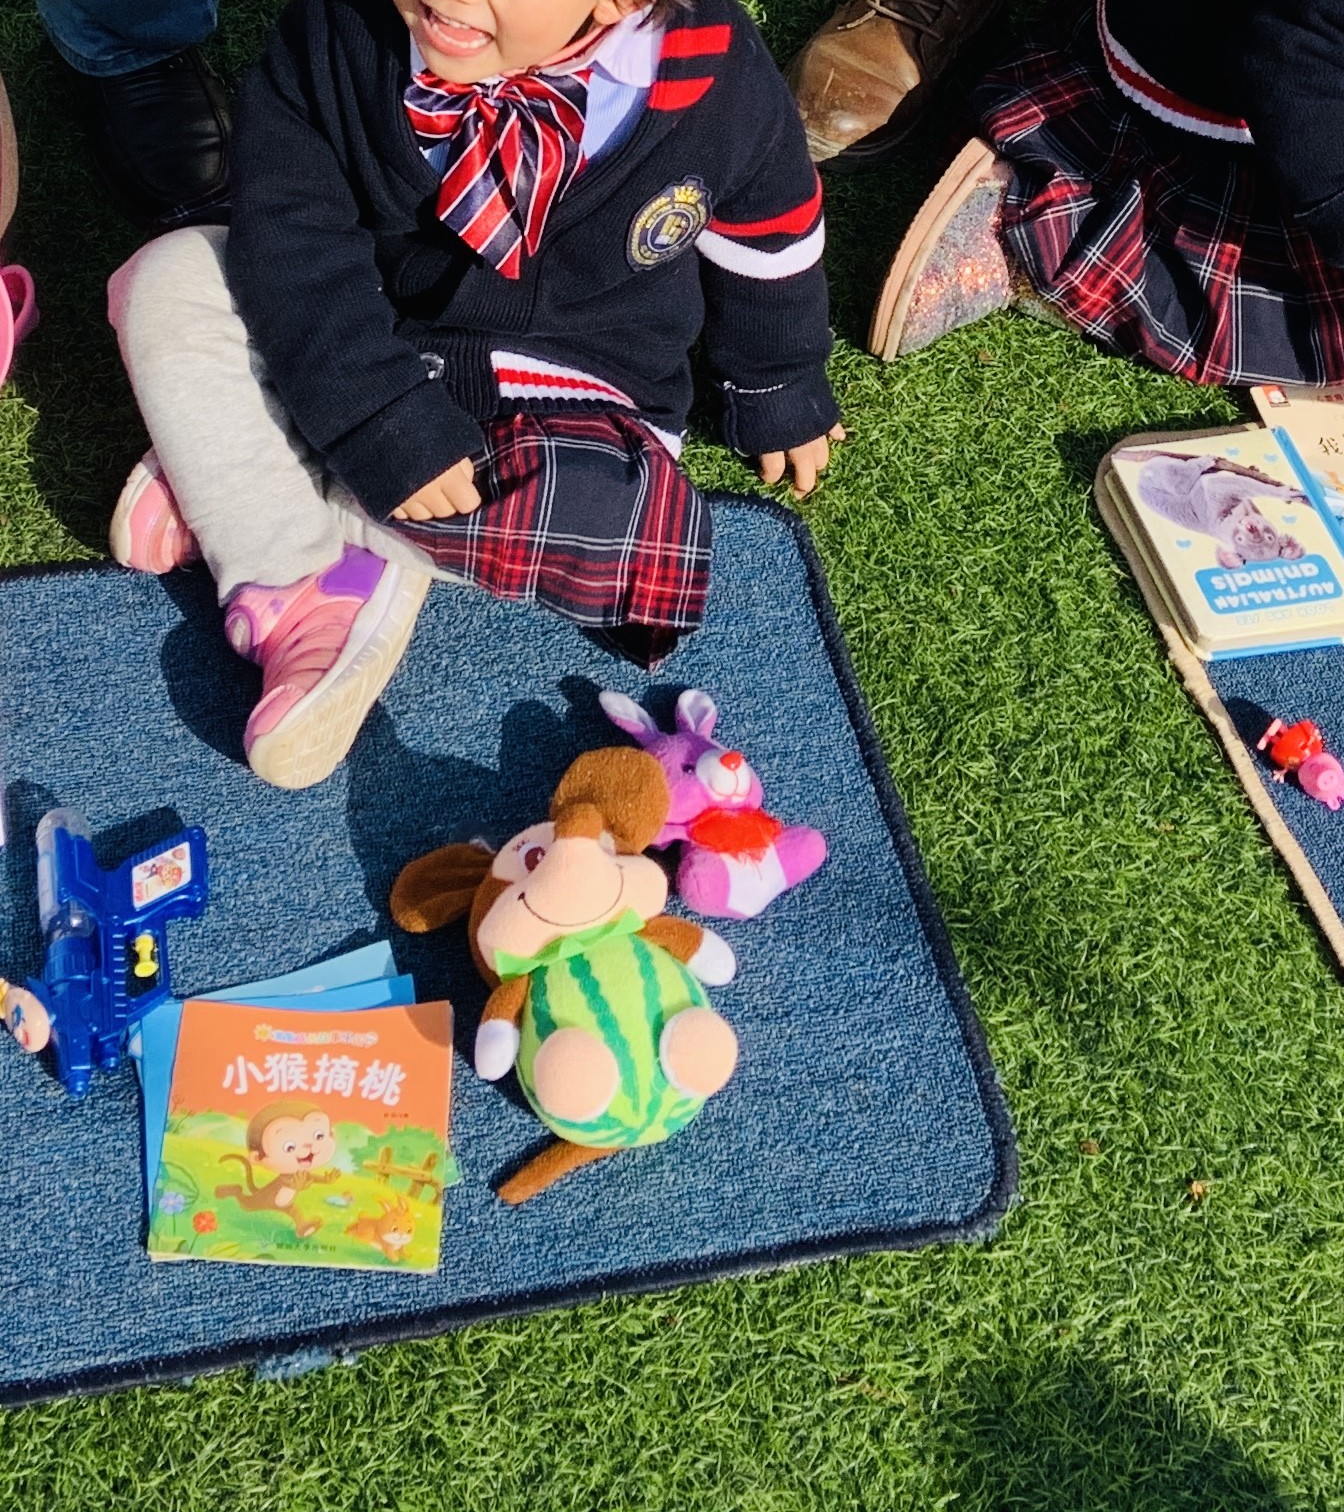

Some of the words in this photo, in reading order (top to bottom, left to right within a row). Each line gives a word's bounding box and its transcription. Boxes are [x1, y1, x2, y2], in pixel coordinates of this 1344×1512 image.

[1210, 562, 1320, 593] animals
[1213, 581, 1336, 611] AUSTRALIAN
[222, 1053, 407, 1107] 小猴摘桃
